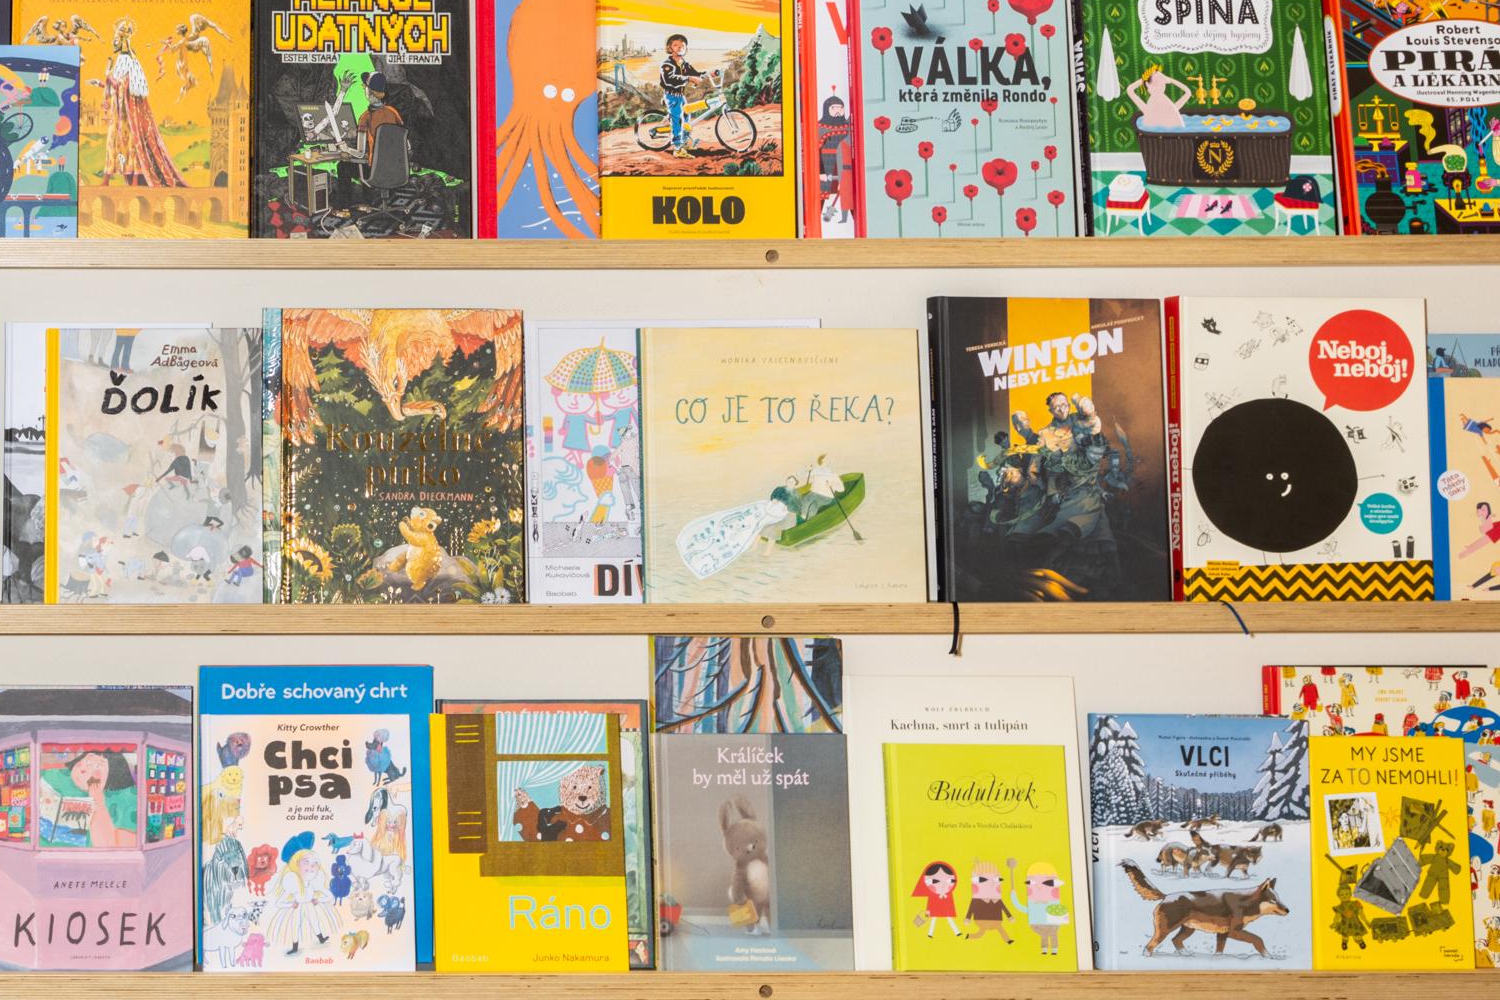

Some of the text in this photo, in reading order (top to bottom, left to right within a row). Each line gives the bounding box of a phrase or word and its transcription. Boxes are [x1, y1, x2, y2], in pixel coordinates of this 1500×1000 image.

[272, 8, 451, 54] UDATNÝCH
[1154, 29, 1261, 41] Smradlavé dějiny hygieny
[1436, 24, 1480, 35] Robert
[1407, 35, 1440, 46] Louis
[895, 36, 1051, 90] VÁLKA,
[1393, 75, 1409, 87] A
[900, 88, 1046, 102] která změnila Rondo
[652, 196, 745, 225] KOLO
[162, 344, 197, 355] Emma
[978, 328, 1123, 377] WINTON
[1318, 340, 1392, 364] Neboj,
[150, 356, 218, 370] AdBågeová
[1334, 360, 1408, 383] neboj!
[994, 360, 1095, 391] NEBYL SÁM
[101, 370, 220, 415] ĎOLÍK
[676, 394, 894, 425] CO JE TO ŘEKA?
[325, 422, 493, 452] Kouzelné
[365, 455, 461, 498] pírko
[379, 491, 474, 501] SANDRA DIECKMANN
[221, 682, 407, 704] Dobře schovaný chrt
[891, 719, 939, 731] Kachna,
[943, 721, 970, 730] smrt
[984, 719, 1028, 733] tulipán
[264, 740, 352, 770] Chci
[717, 747, 784, 764] Králíček
[1180, 745, 1229, 768] VLCI
[1351, 747, 1425, 763] MY JSME
[692, 769, 809, 788] by měl už spát
[1175, 770, 1237, 780] Skutečné příběhy
[1321, 768, 1459, 786] ZA TO NEMOHLI!
[269, 773, 351, 806] psa
[927, 771, 1046, 814] Budulínek
[295, 805, 303, 814] je
[316, 805, 331, 813] fuk,
[298, 813, 318, 821] bude
[319, 813, 334, 821] zač
[54, 880, 128, 889] ANETE MELECE
[509, 895, 612, 929] Ráno
[14, 911, 166, 948] KIOSEK
[563, 954, 609, 962] Nakamura
